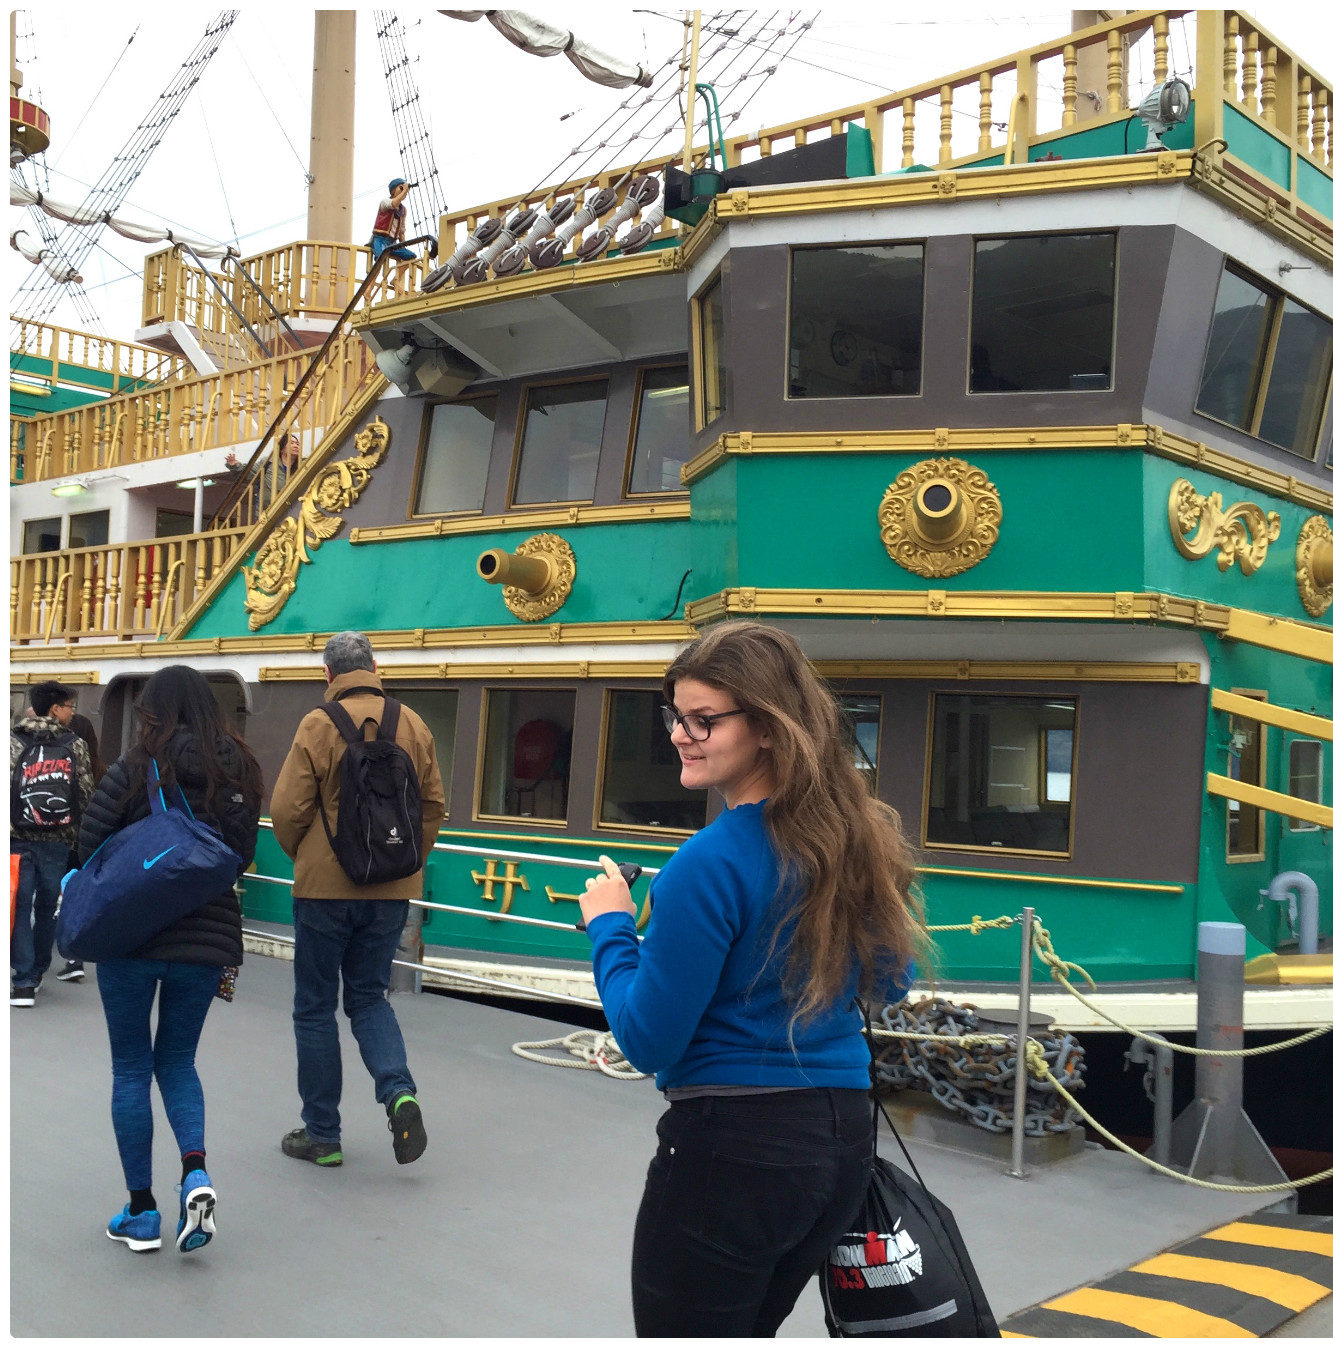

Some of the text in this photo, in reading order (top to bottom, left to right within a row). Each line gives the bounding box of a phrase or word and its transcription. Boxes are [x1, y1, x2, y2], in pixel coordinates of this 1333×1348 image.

[24, 758, 71, 780] RIP CURL
[830, 1230, 916, 1267] RONMAN
